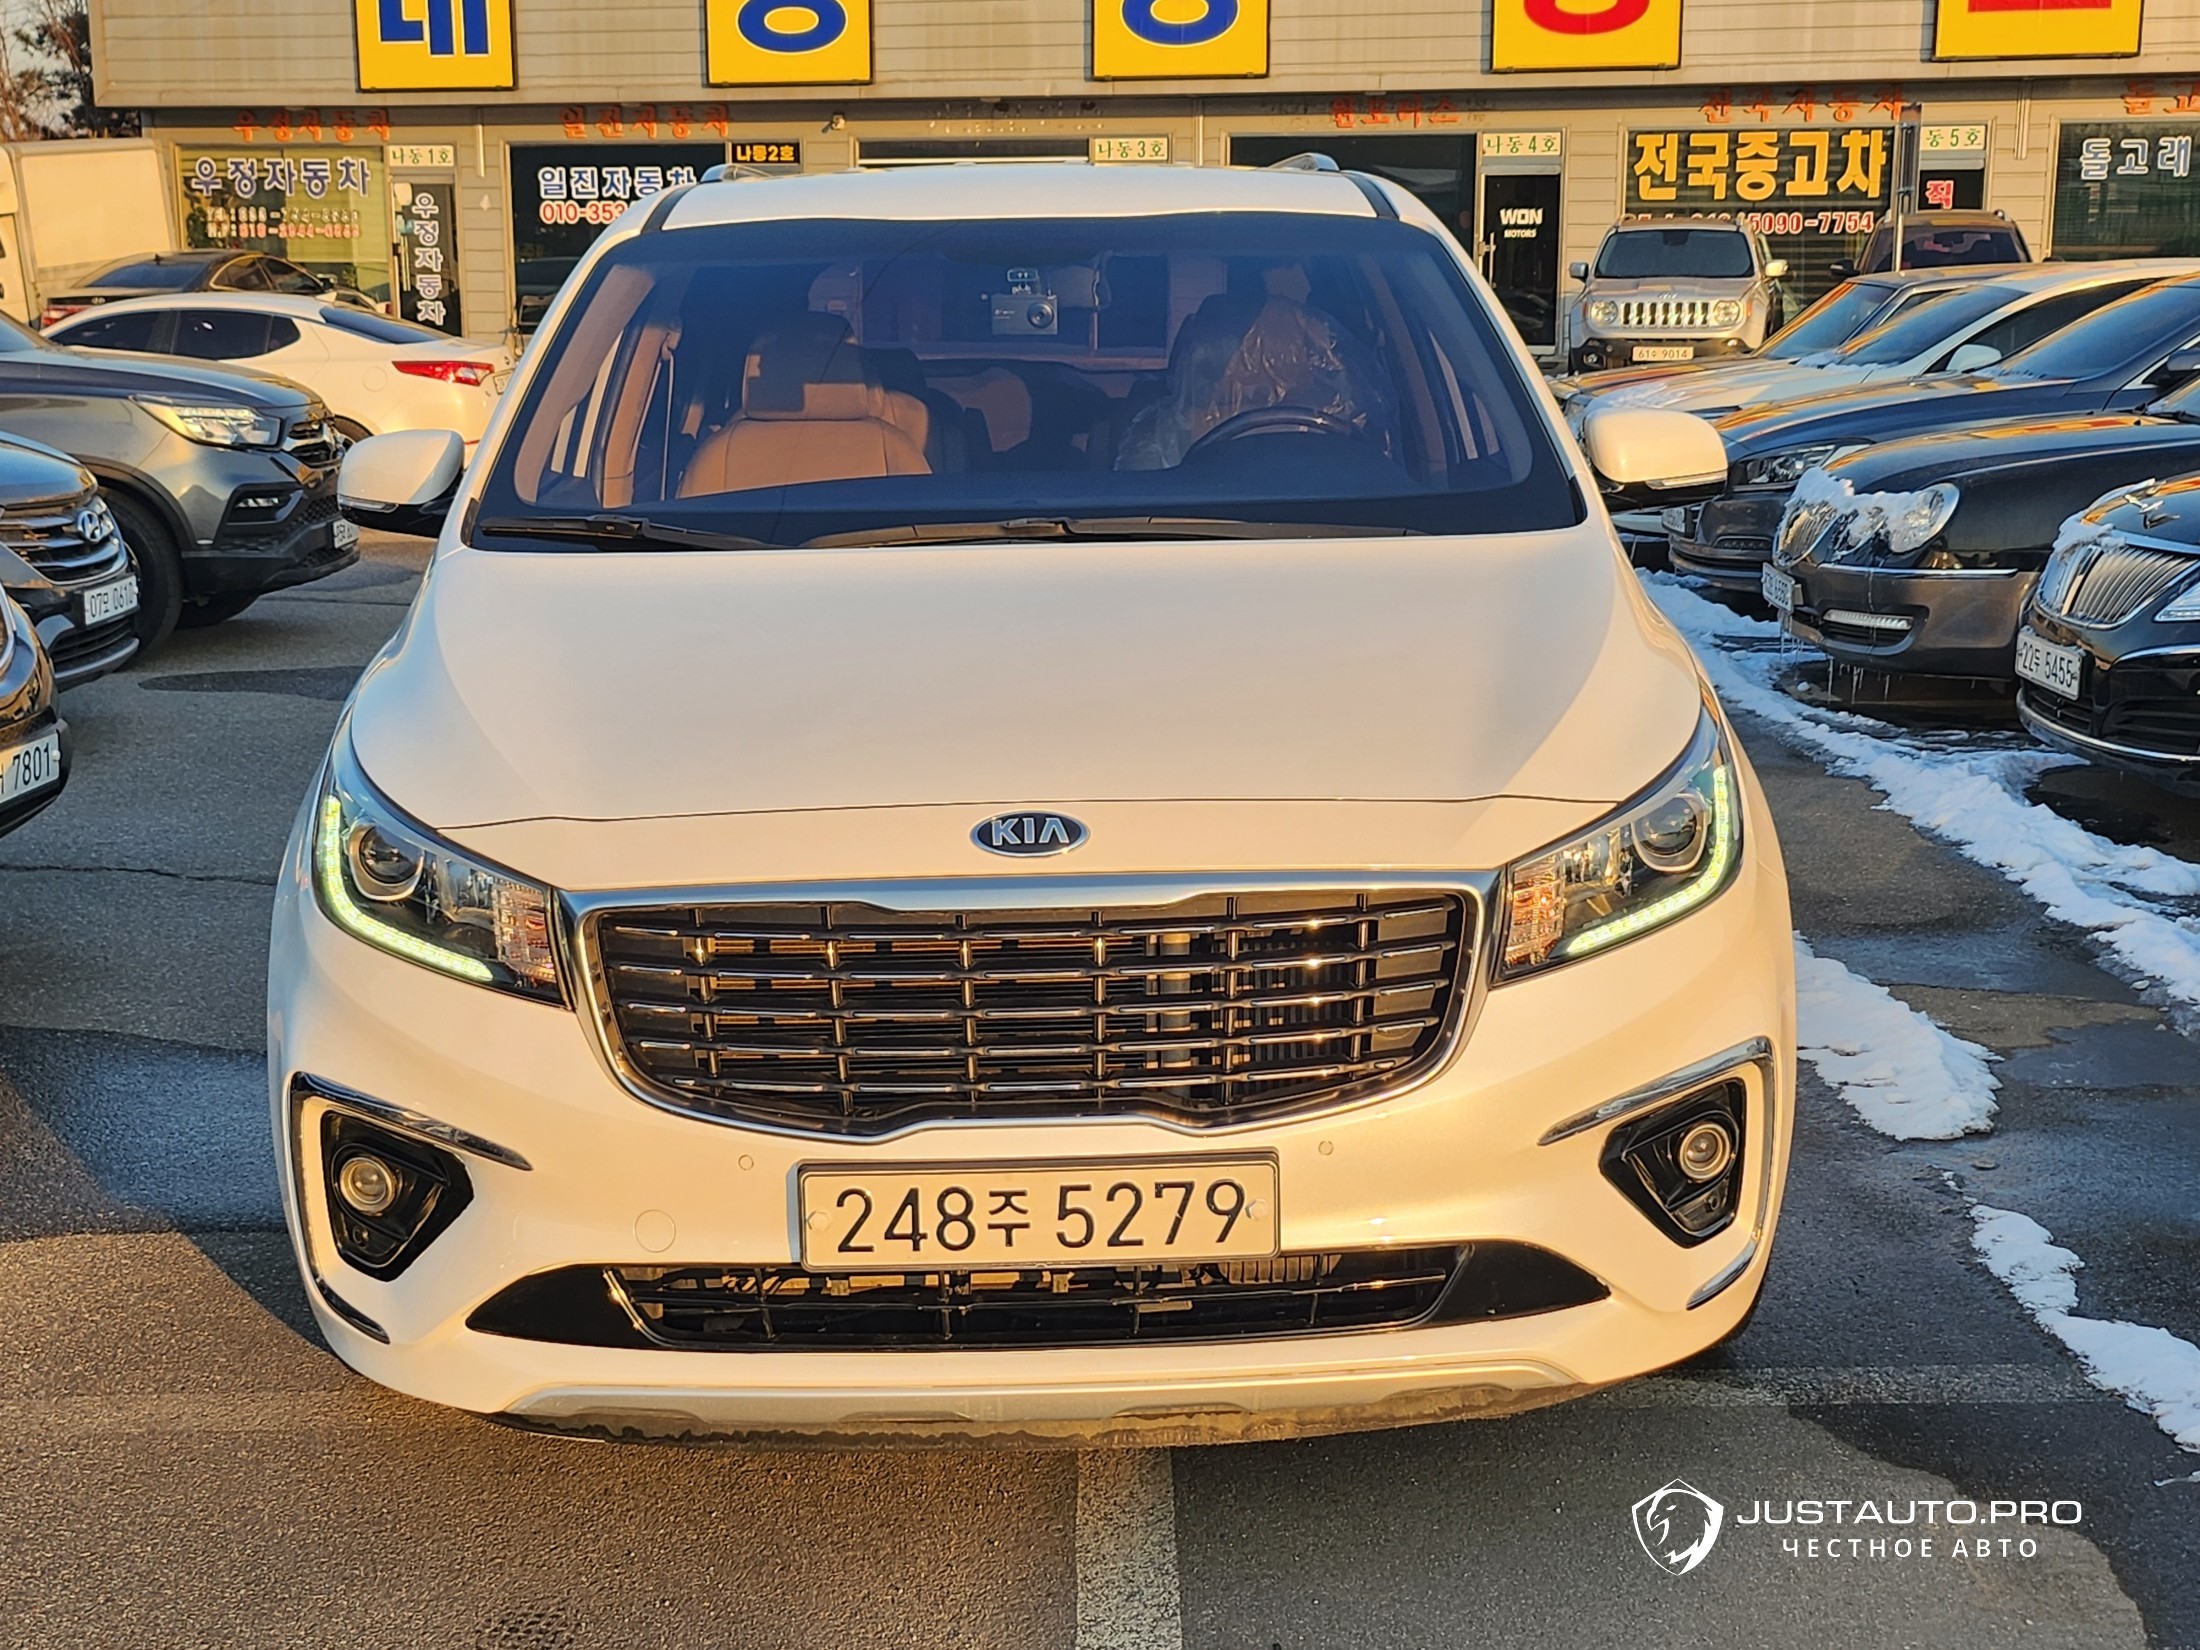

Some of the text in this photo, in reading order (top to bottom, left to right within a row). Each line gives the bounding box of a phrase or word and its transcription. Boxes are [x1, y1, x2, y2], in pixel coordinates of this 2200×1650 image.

[1097, 139, 1164, 159] 나동3호
[1485, 134, 1560, 154] 나동4호
[2079, 135, 2193, 180] 돌고래
[191, 156, 371, 199] 우정자동차
[1633, 129, 1887, 201] 전국중고차
[1499, 207, 1544, 226] WON
[1504, 229, 1538, 239] MOTORS
[411, 192, 446, 326] 우정자동차
[1661, 350, 1688, 359] 9014
[2044, 651, 2073, 688] 5455
[12, 742, 50, 791] 7801
[991, 817, 1070, 846] KIA
[834, 1178, 1246, 1253] 248주 5279
